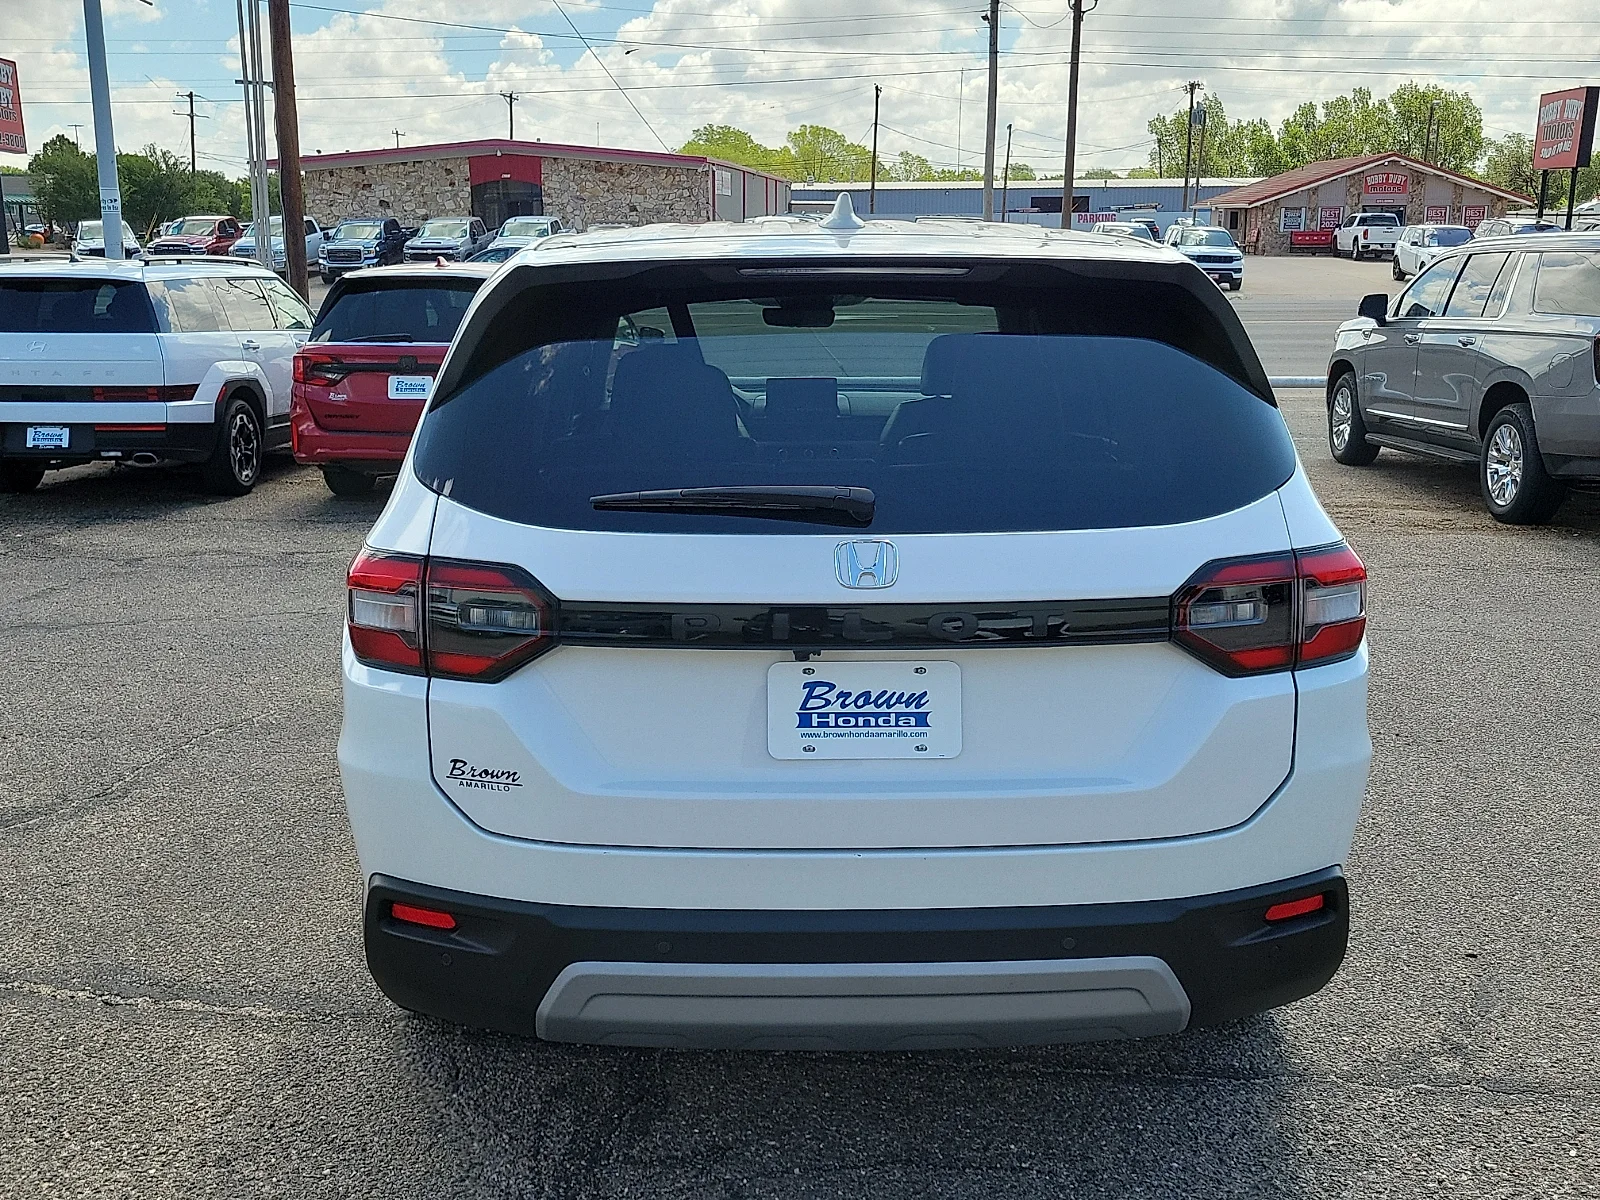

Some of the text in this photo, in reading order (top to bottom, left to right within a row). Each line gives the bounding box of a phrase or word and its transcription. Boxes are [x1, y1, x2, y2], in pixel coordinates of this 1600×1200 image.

[1542, 121, 1575, 142] motors
[1366, 174, 1387, 185] BOBBY
[1369, 185, 1402, 193] motors
[1077, 213, 1117, 223] PARKING
[1322, 210, 1339, 218] BEST
[1428, 209, 1446, 217] BEST
[1466, 209, 1484, 217] BEST
[671, 608, 1067, 642] PILOT
[799, 680, 930, 711] Brown
[811, 713, 916, 727] Honda
[800, 730, 928, 739] www.brownhondaamarillo.com
[449, 759, 521, 783] Brown
[458, 780, 511, 792] AMARILLO
